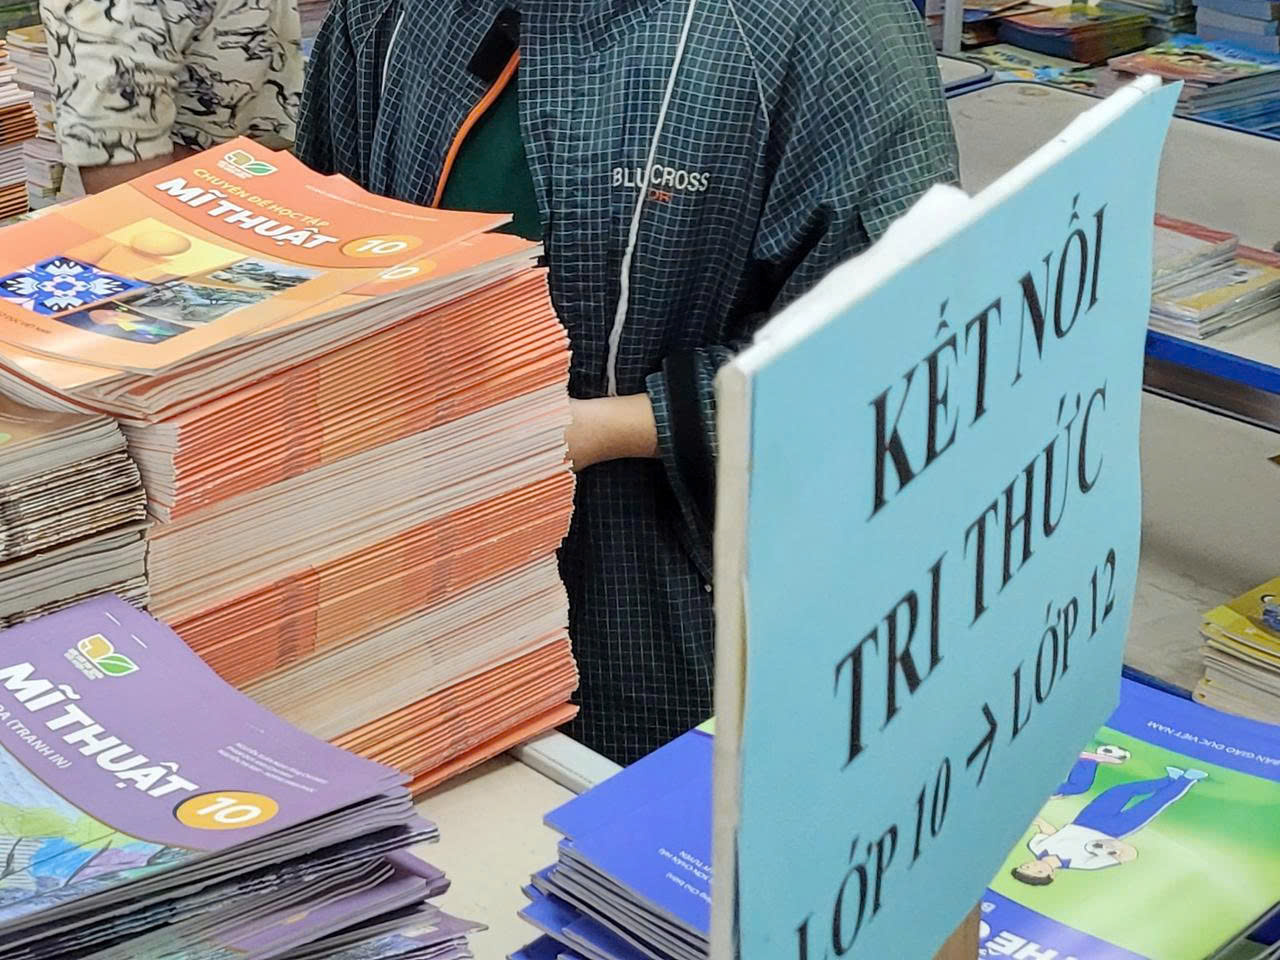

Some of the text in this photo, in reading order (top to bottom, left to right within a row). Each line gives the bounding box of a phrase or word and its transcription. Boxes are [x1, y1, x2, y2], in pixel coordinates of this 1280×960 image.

[193, 168, 250, 198] CHUYÊN
[154, 177, 228, 208] MĨ
[207, 200, 340, 249] THUẬT
[355, 238, 409, 255] 10
[377, 265, 419, 281] 0
[867, 193, 1108, 522] KẾT NỐI
[834, 379, 1108, 772] TRI THỨC
[910, 756, 952, 869] 10
[1010, 600, 1078, 742] LỚP
[1088, 547, 1117, 639] 12
[1147, 720, 1175, 735] NAM
[1174, 730, 1199, 743] VIỆT
[6, 717, 51, 761] (TRANH
[48, 749, 73, 770] IN)
[46, 703, 199, 798] THUẬT
[1198, 738, 1225, 751] DỤC
[1225, 746, 1255, 759] GIÁO
[195, 796, 262, 824] 10
